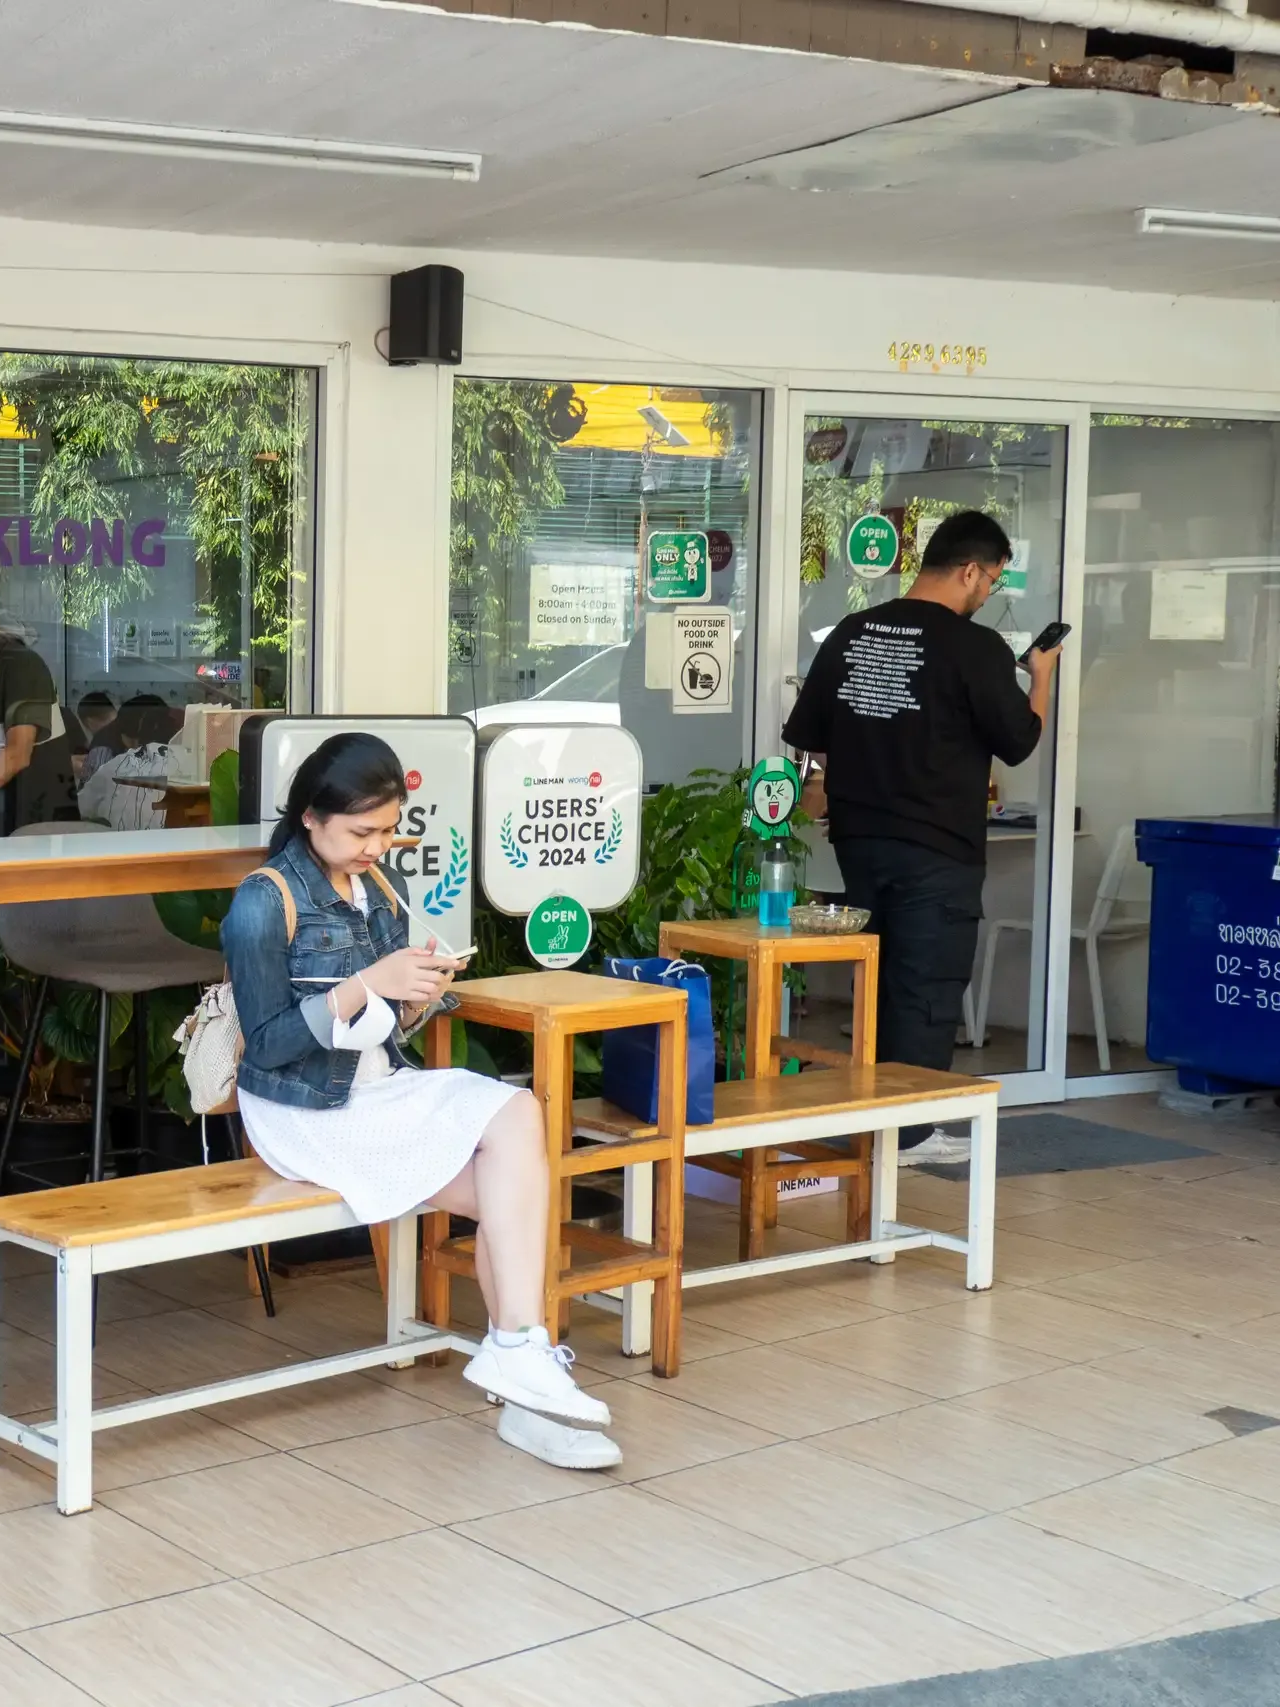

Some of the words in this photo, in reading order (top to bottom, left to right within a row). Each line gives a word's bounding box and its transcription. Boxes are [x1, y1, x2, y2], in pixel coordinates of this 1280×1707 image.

[860, 527, 889, 539] OPEN
[709, 545, 731, 553] CHELIN
[655, 553, 680, 562] ONLY
[551, 584, 576, 595] Open
[538, 599, 573, 609] 8:00am
[536, 614, 568, 624] Closed
[584, 614, 617, 626] Sunday
[677, 619, 690, 628] NO
[691, 619, 726, 628] OUTSIDE
[684, 629, 706, 638] FOOD
[707, 629, 719, 638] OR
[688, 640, 714, 649] DRINK
[525, 796, 604, 820] USERS'
[517, 821, 606, 844] CHOICE
[385, 845, 440, 877] ICE
[539, 848, 586, 867] 2024
[740, 893, 760, 909] LIN
[541, 910, 578, 923] OPEN
[798, 1177, 821, 1189] MAN
